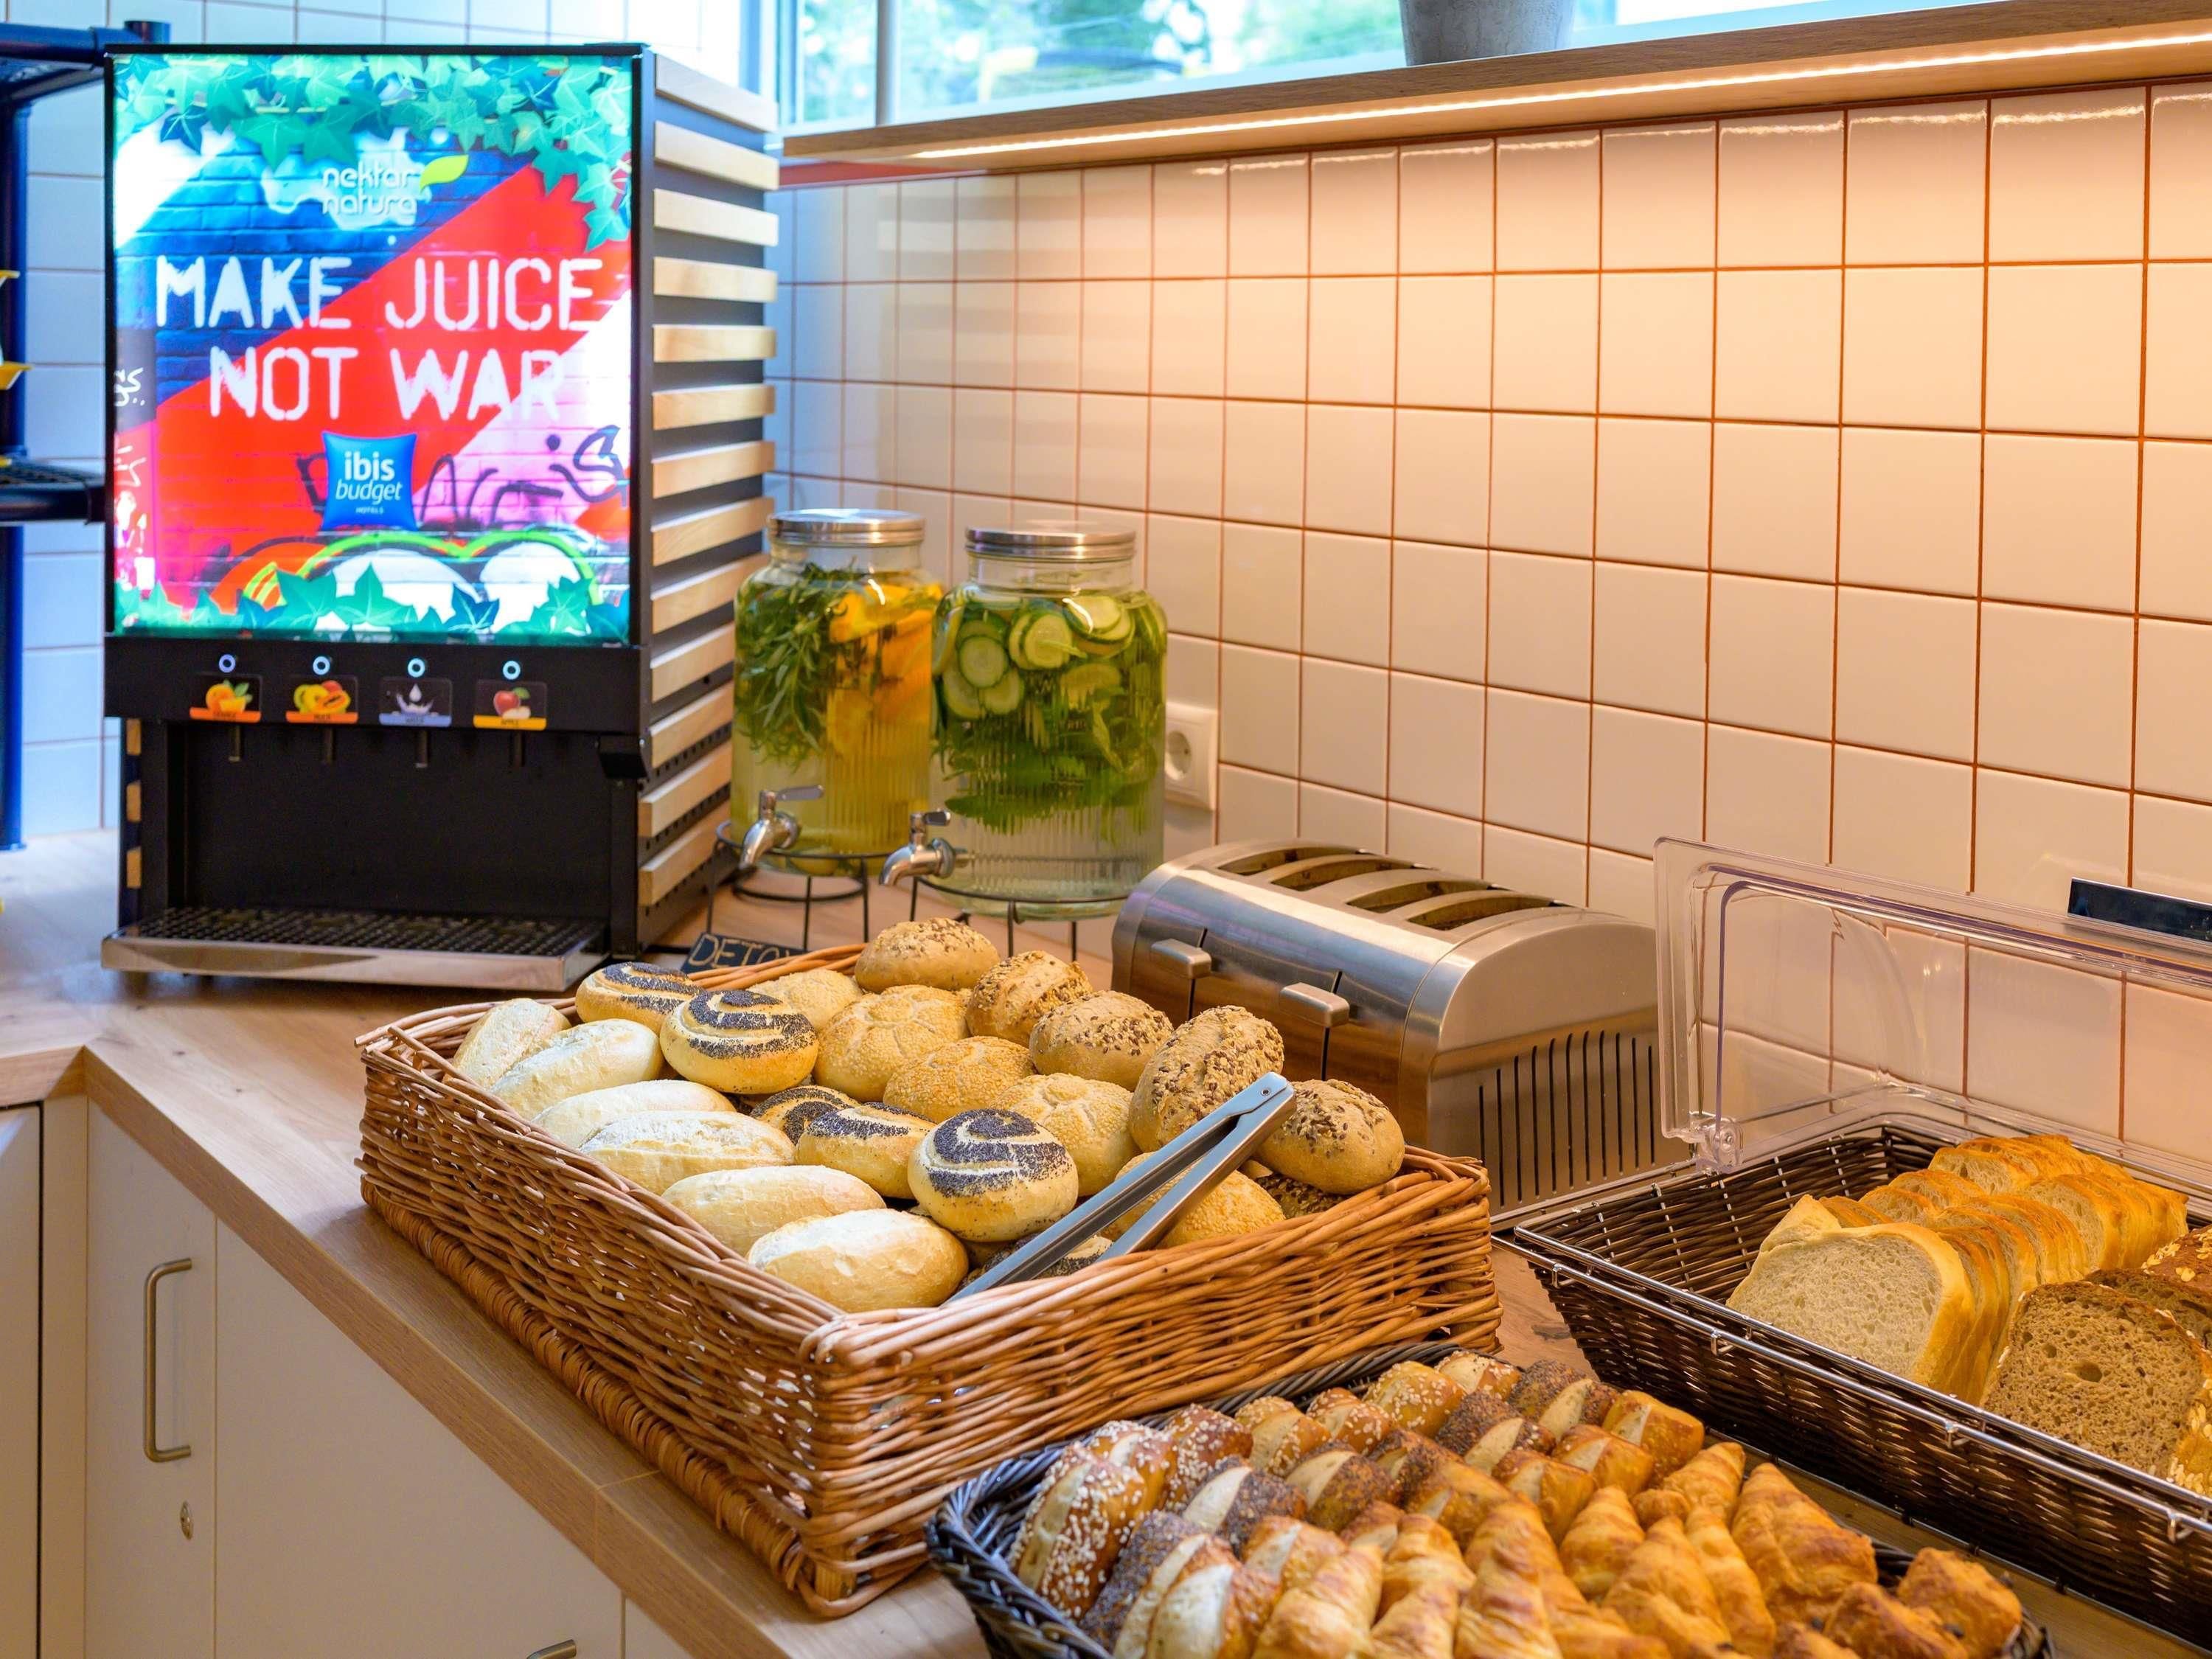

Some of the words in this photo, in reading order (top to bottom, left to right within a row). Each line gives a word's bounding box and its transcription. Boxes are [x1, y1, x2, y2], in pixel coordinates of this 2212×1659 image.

[322, 159, 421, 189] nektar
[322, 189, 417, 215] natura
[156, 255, 352, 329] MAKE
[385, 257, 602, 331] JUICE
[209, 346, 359, 420] NOT
[389, 348, 563, 421] WAR
[344, 451, 395, 481] ibis
[335, 478, 403, 505] budget
[688, 933, 790, 969] DETO
